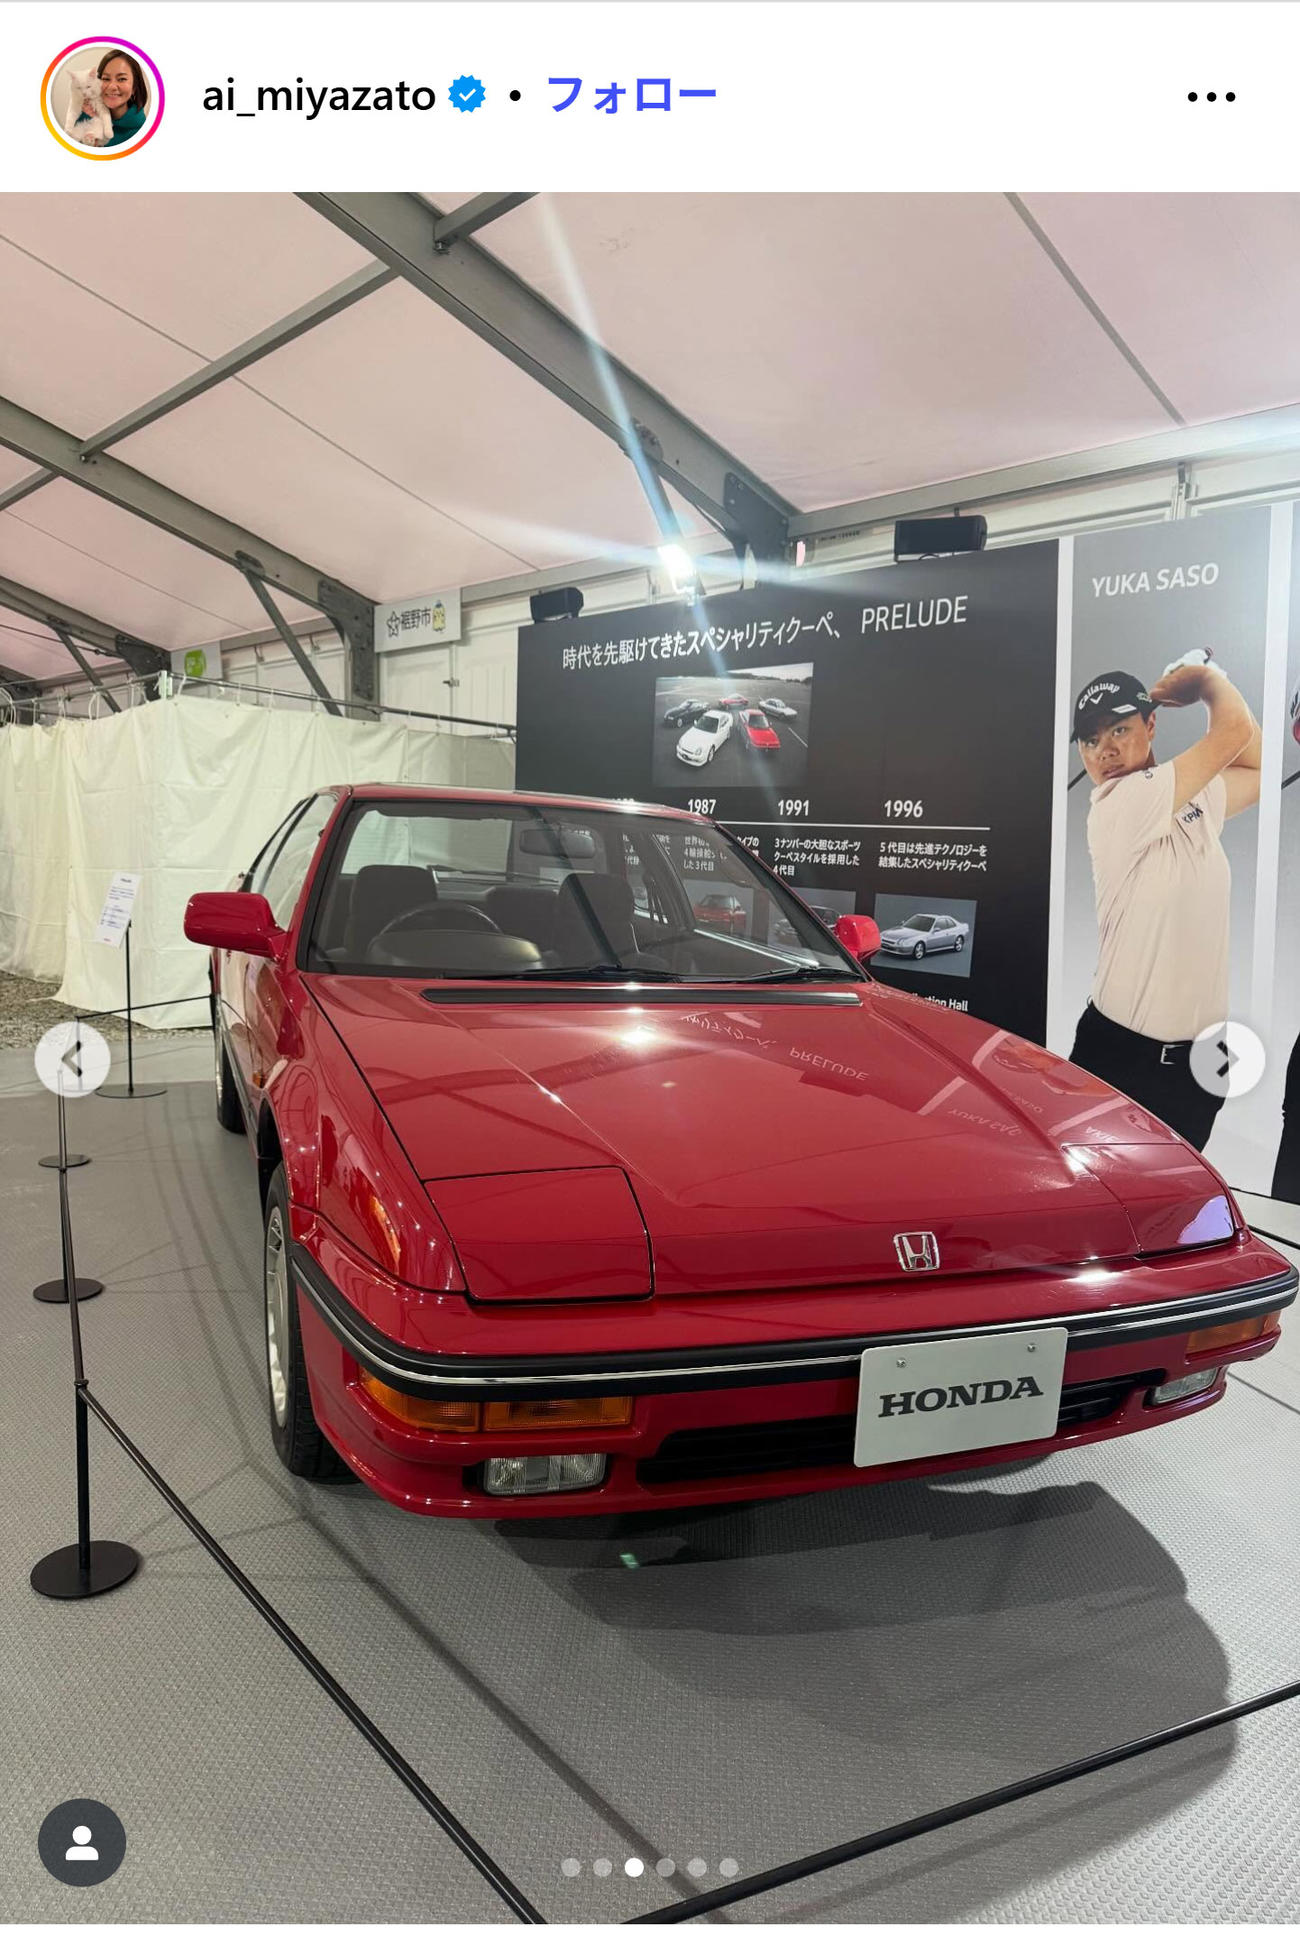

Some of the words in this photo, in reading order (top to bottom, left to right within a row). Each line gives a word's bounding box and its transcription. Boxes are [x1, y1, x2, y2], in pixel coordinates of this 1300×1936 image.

[1091, 571, 1150, 598] YUKA
[1156, 562, 1220, 591] SASO
[861, 595, 969, 634] PRELUDE
[1078, 682, 1120, 711] Callaway
[687, 798, 717, 815] 1987
[777, 799, 810, 817] 1991
[884, 799, 924, 818] 1996
[948, 998, 969, 1012] Hall
[878, 1375, 1044, 1418] HONDA
